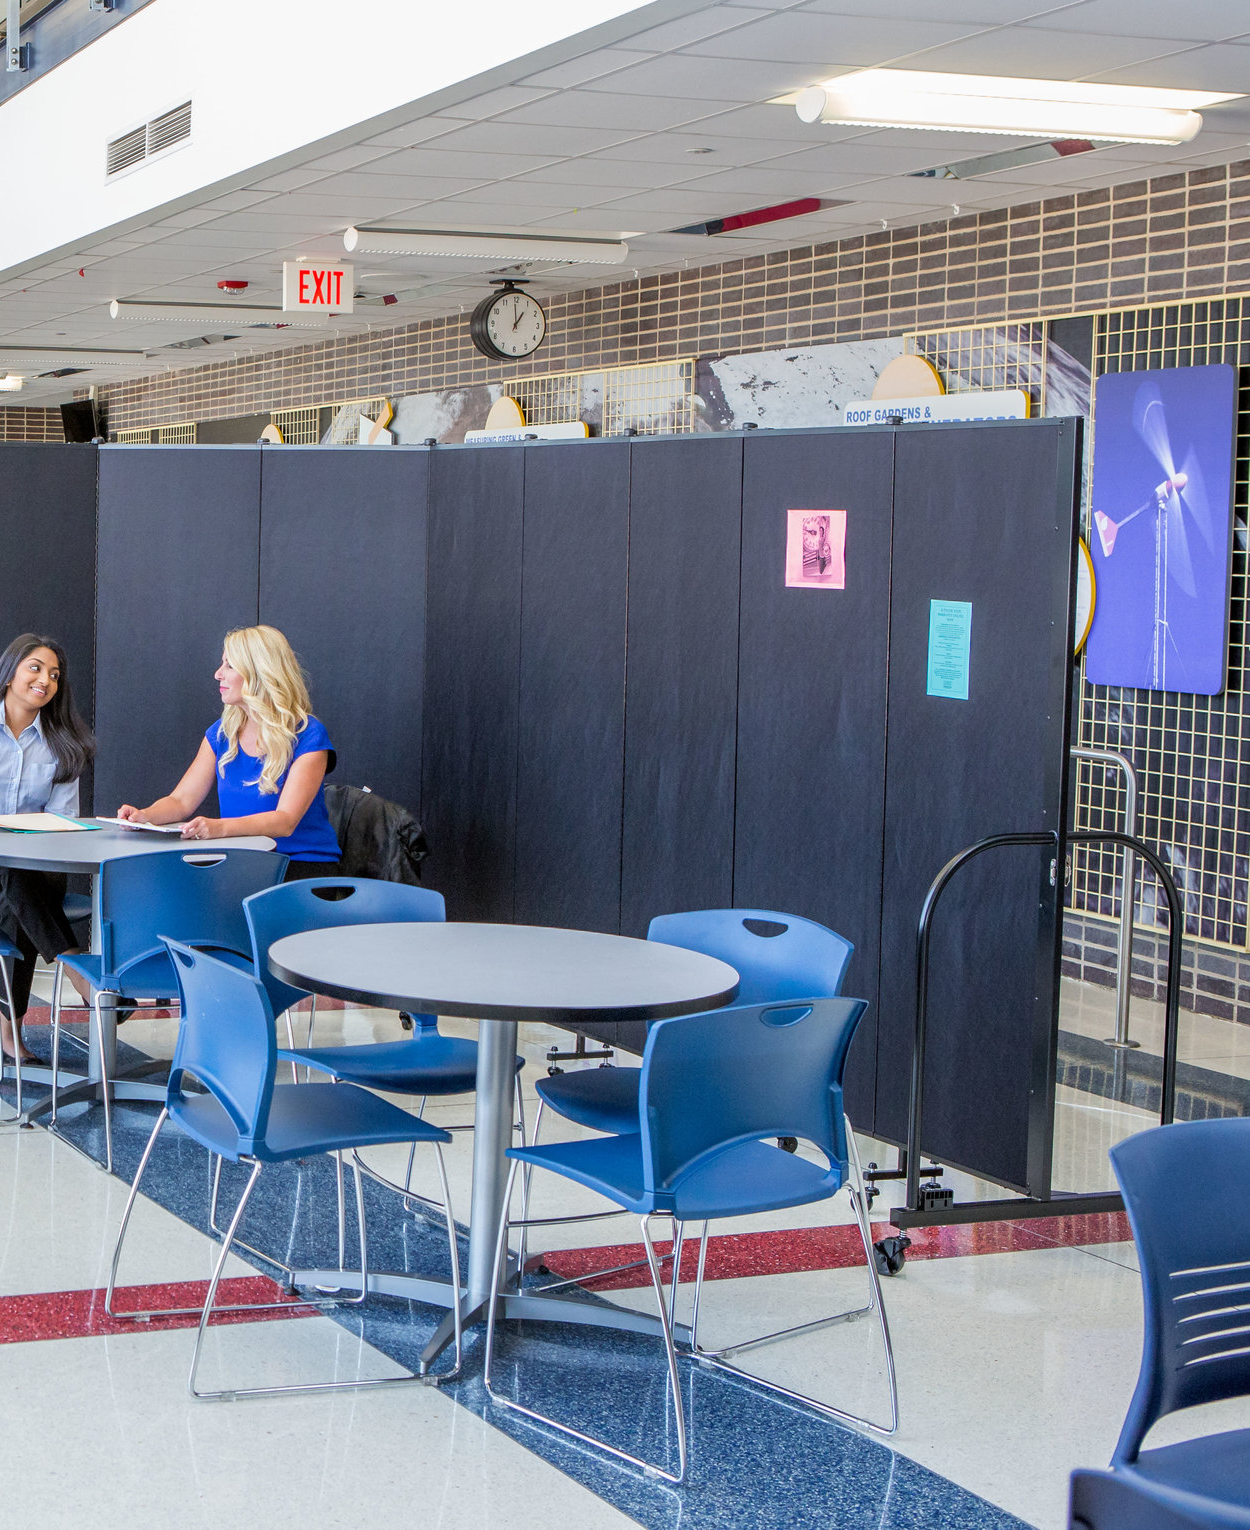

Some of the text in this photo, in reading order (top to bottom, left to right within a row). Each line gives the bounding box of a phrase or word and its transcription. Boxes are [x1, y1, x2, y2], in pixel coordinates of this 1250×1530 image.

[299, 270, 344, 305] EXIT
[513, 296, 519, 304] 12
[493, 308, 500, 316] 10
[533, 310, 538, 318] 2
[491, 320, 495, 328] 9
[536, 322, 540, 330] 3
[493, 332, 498, 340] 8
[532, 334, 537, 342] 4
[512, 345, 517, 353] 6
[523, 343, 528, 351] 5
[846, 410, 871, 423] ROOF
[874, 406, 921, 421] GARDENS
[924, 406, 931, 418] &
